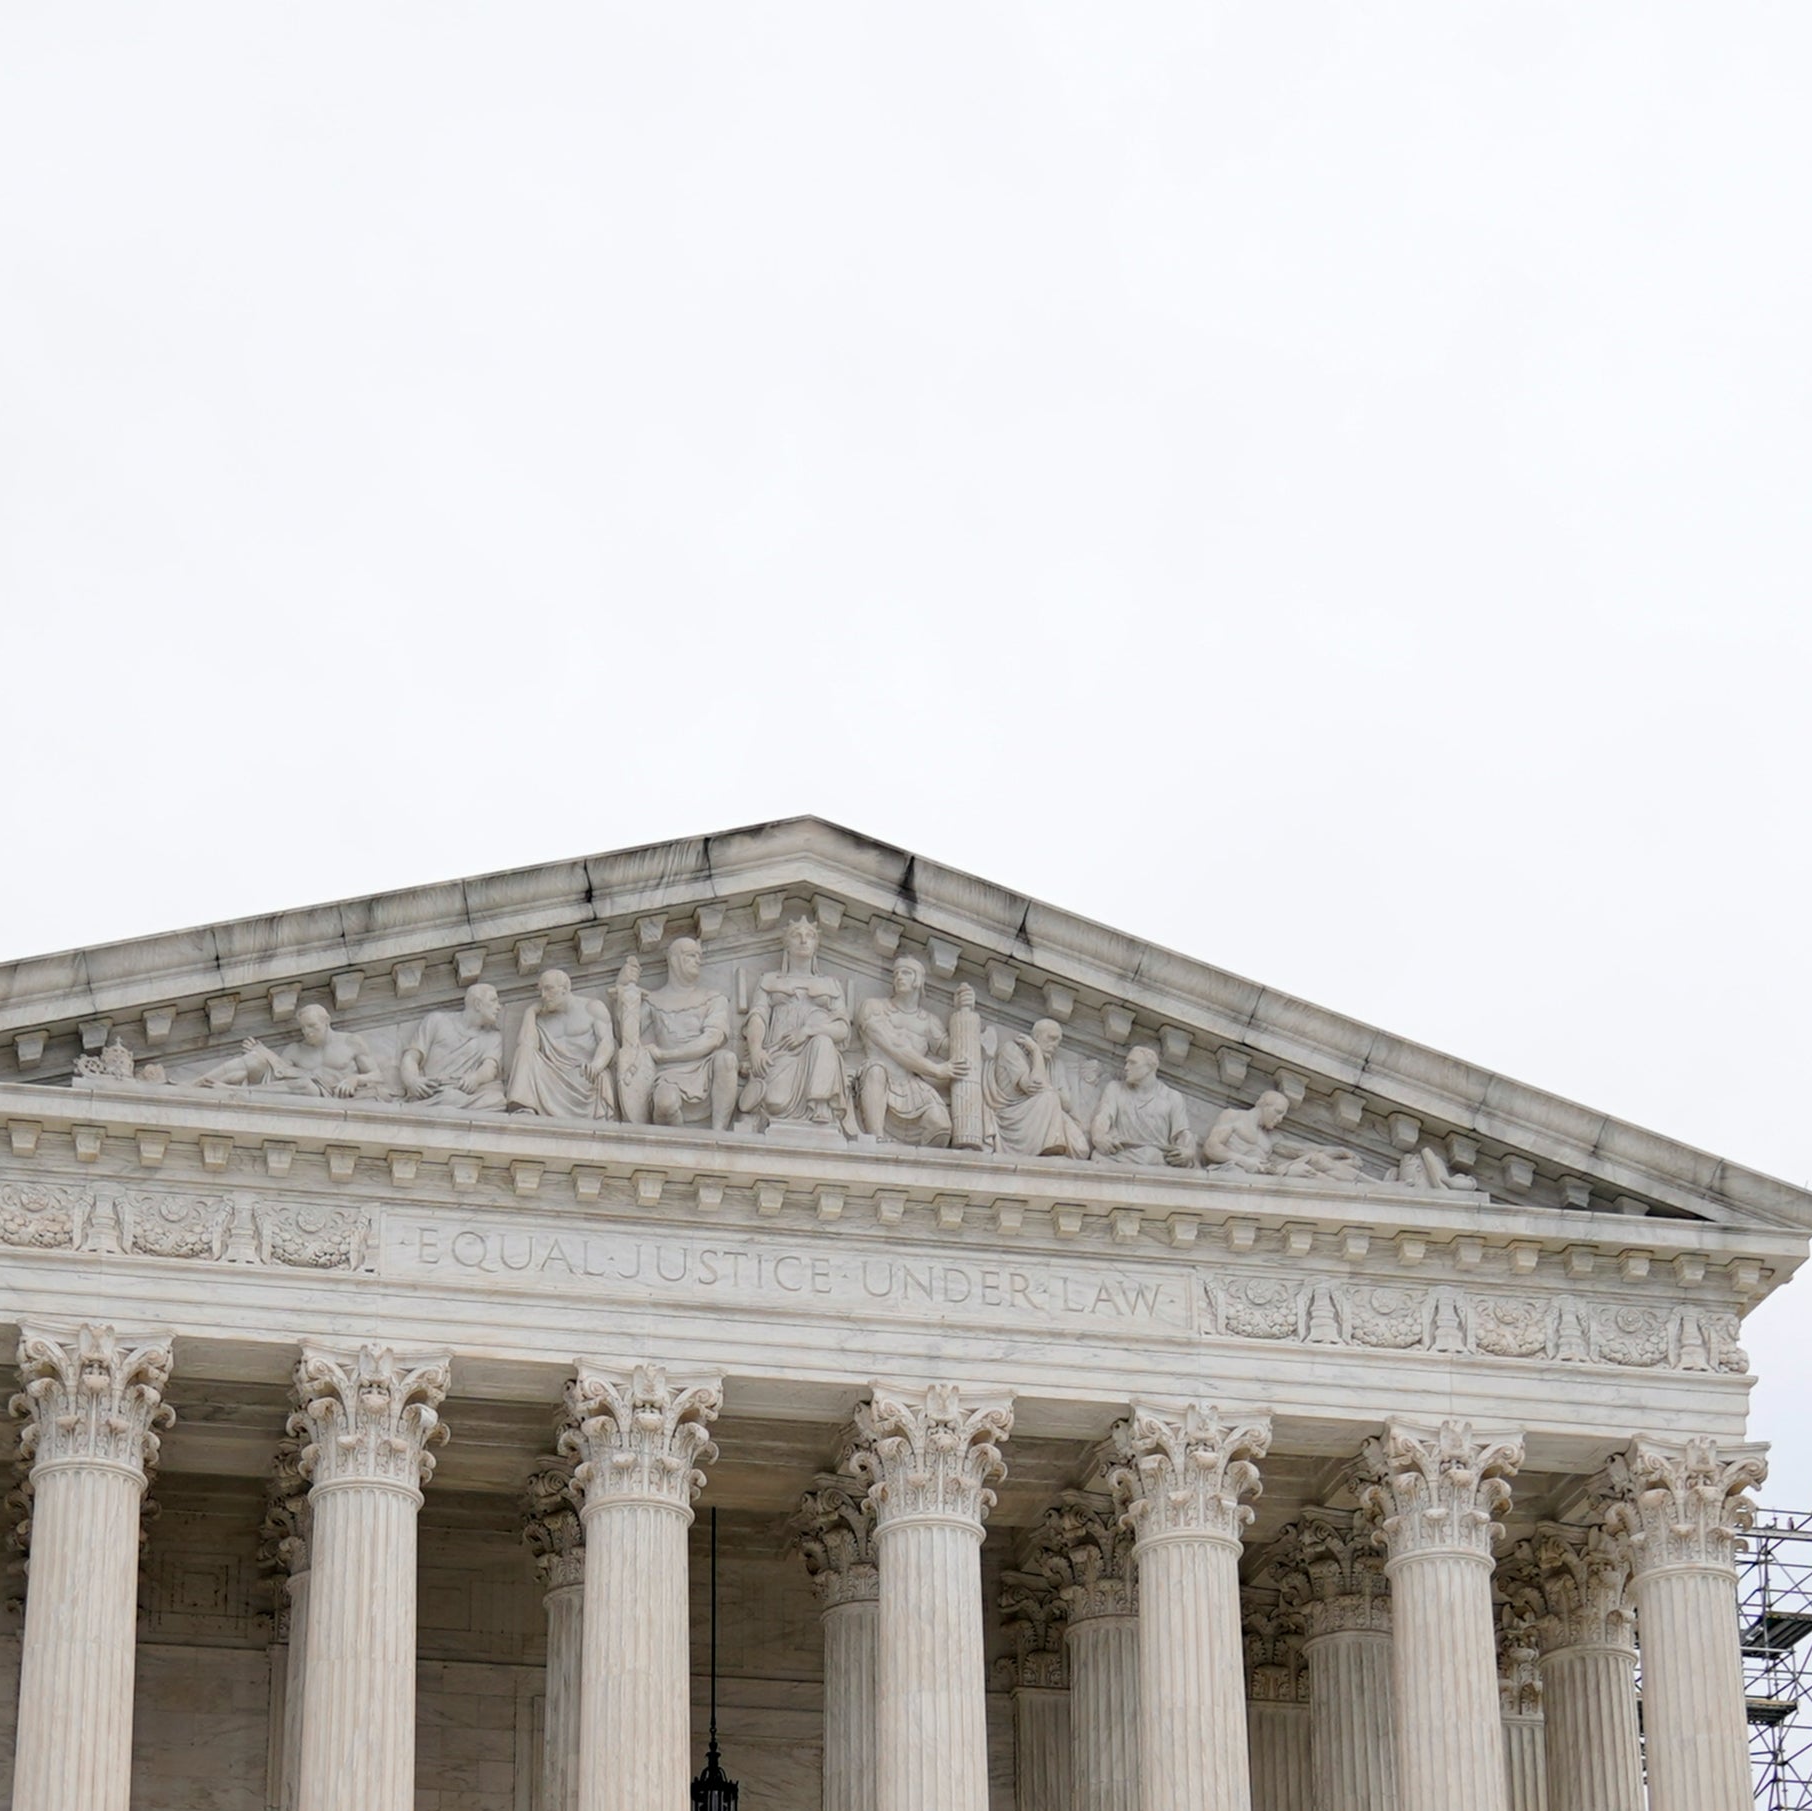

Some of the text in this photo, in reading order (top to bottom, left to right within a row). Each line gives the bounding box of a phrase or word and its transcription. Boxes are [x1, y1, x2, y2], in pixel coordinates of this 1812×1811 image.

[416, 1227, 1162, 1317] EQUAL JUSTICE UNDER LAW
